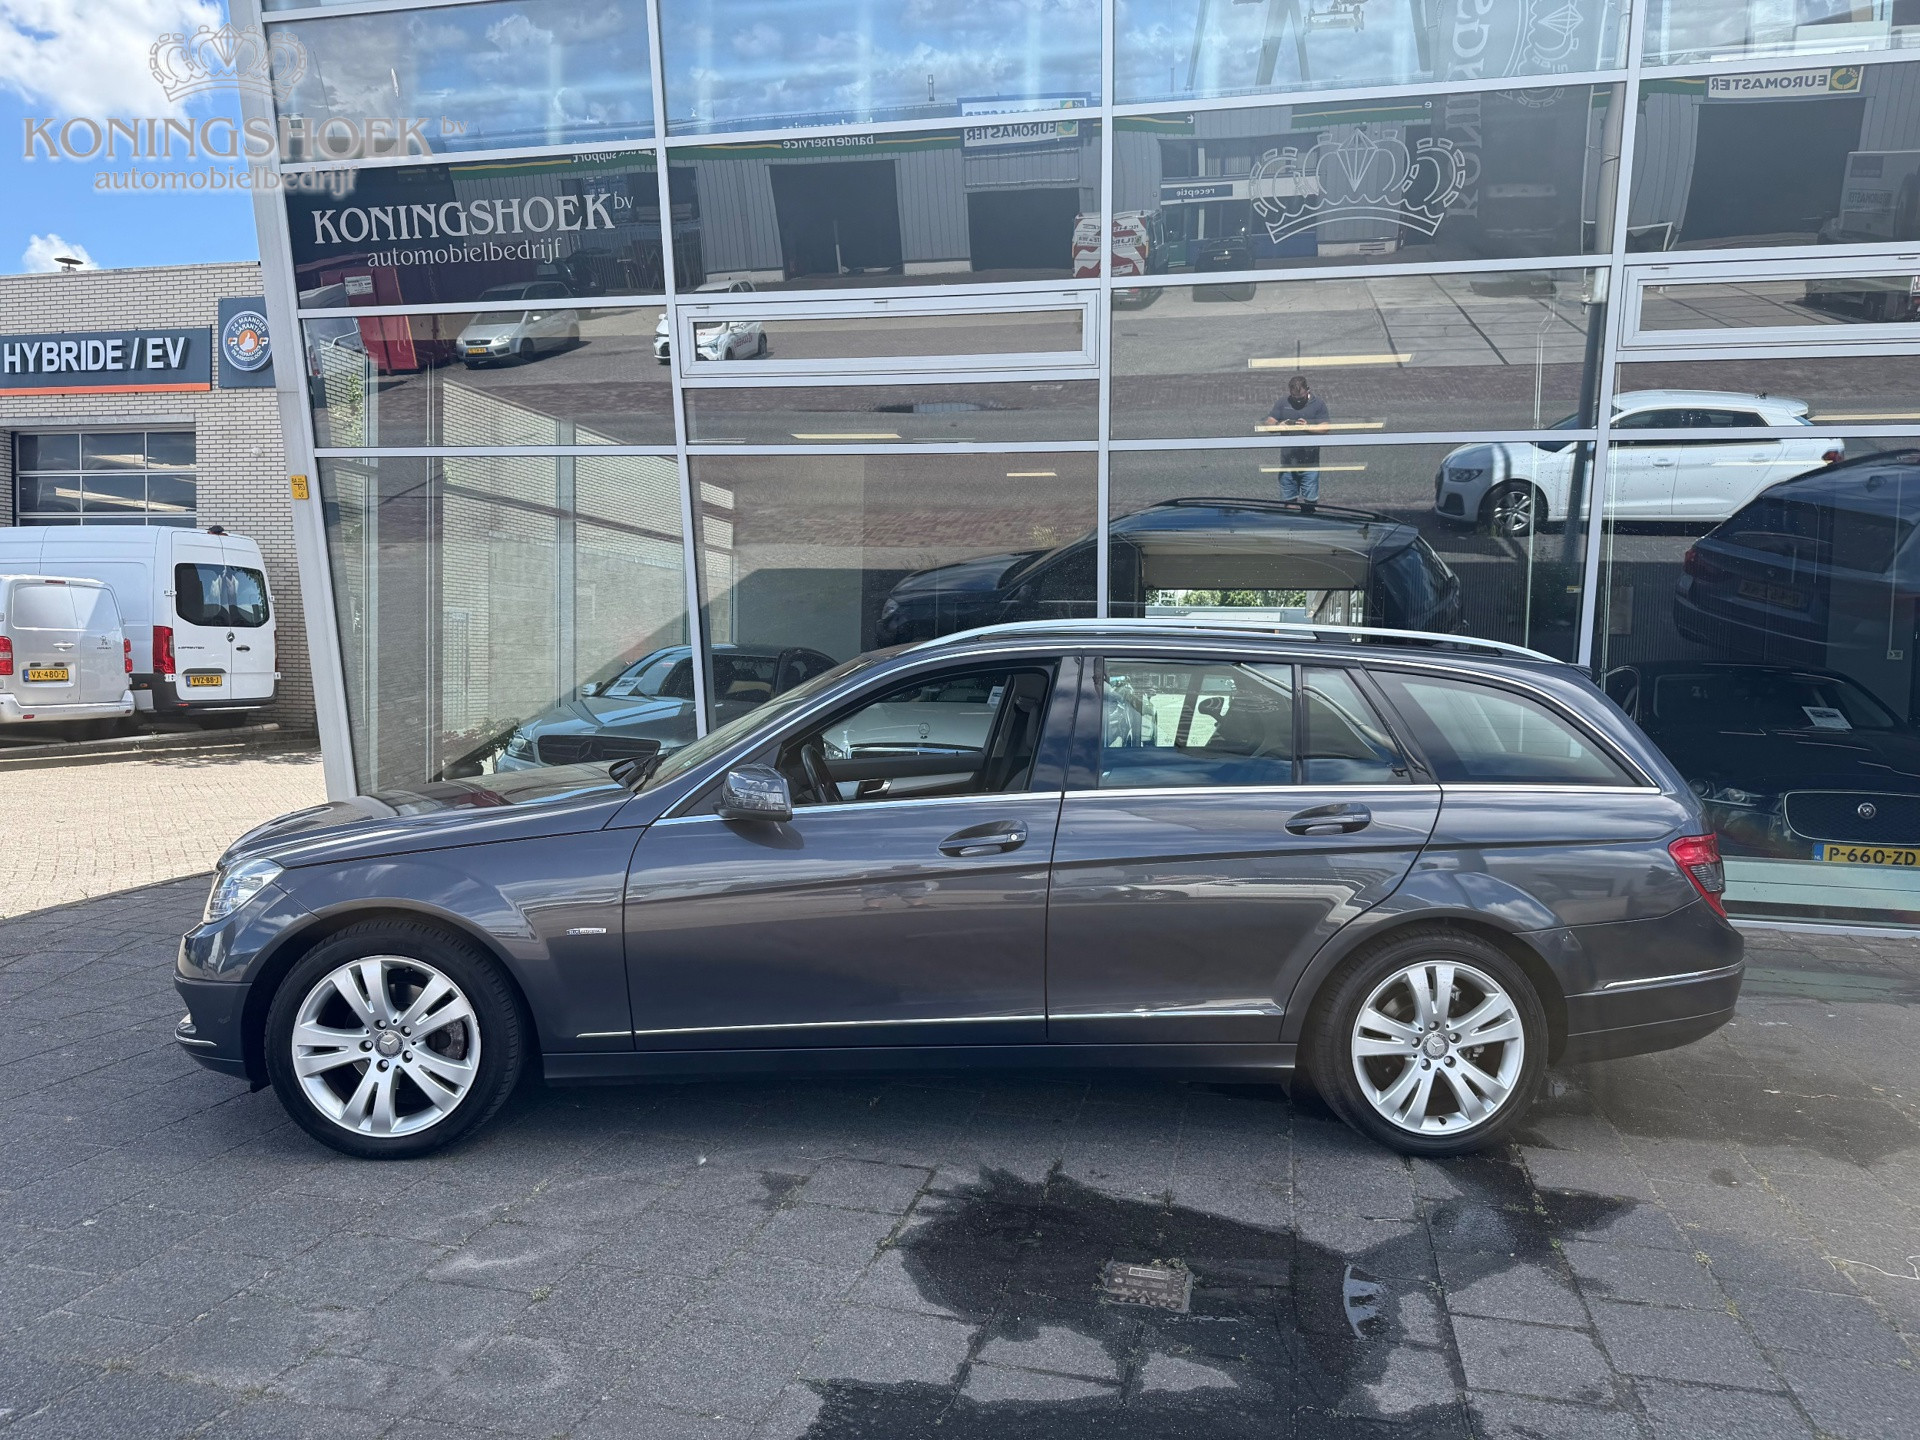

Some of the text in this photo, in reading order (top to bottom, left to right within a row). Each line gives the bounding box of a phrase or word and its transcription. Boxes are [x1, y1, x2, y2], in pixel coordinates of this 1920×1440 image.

[311, 191, 634, 244] KONINGSHOEK bv
[367, 237, 562, 266] automobielbedrijf
[231, 316, 267, 332] 24 MAANDEN
[235, 323, 263, 336] GARANTIE
[3, 336, 185, 373] HYBRIDE / EV
[1828, 847, 1917, 866] P-660-ZD
